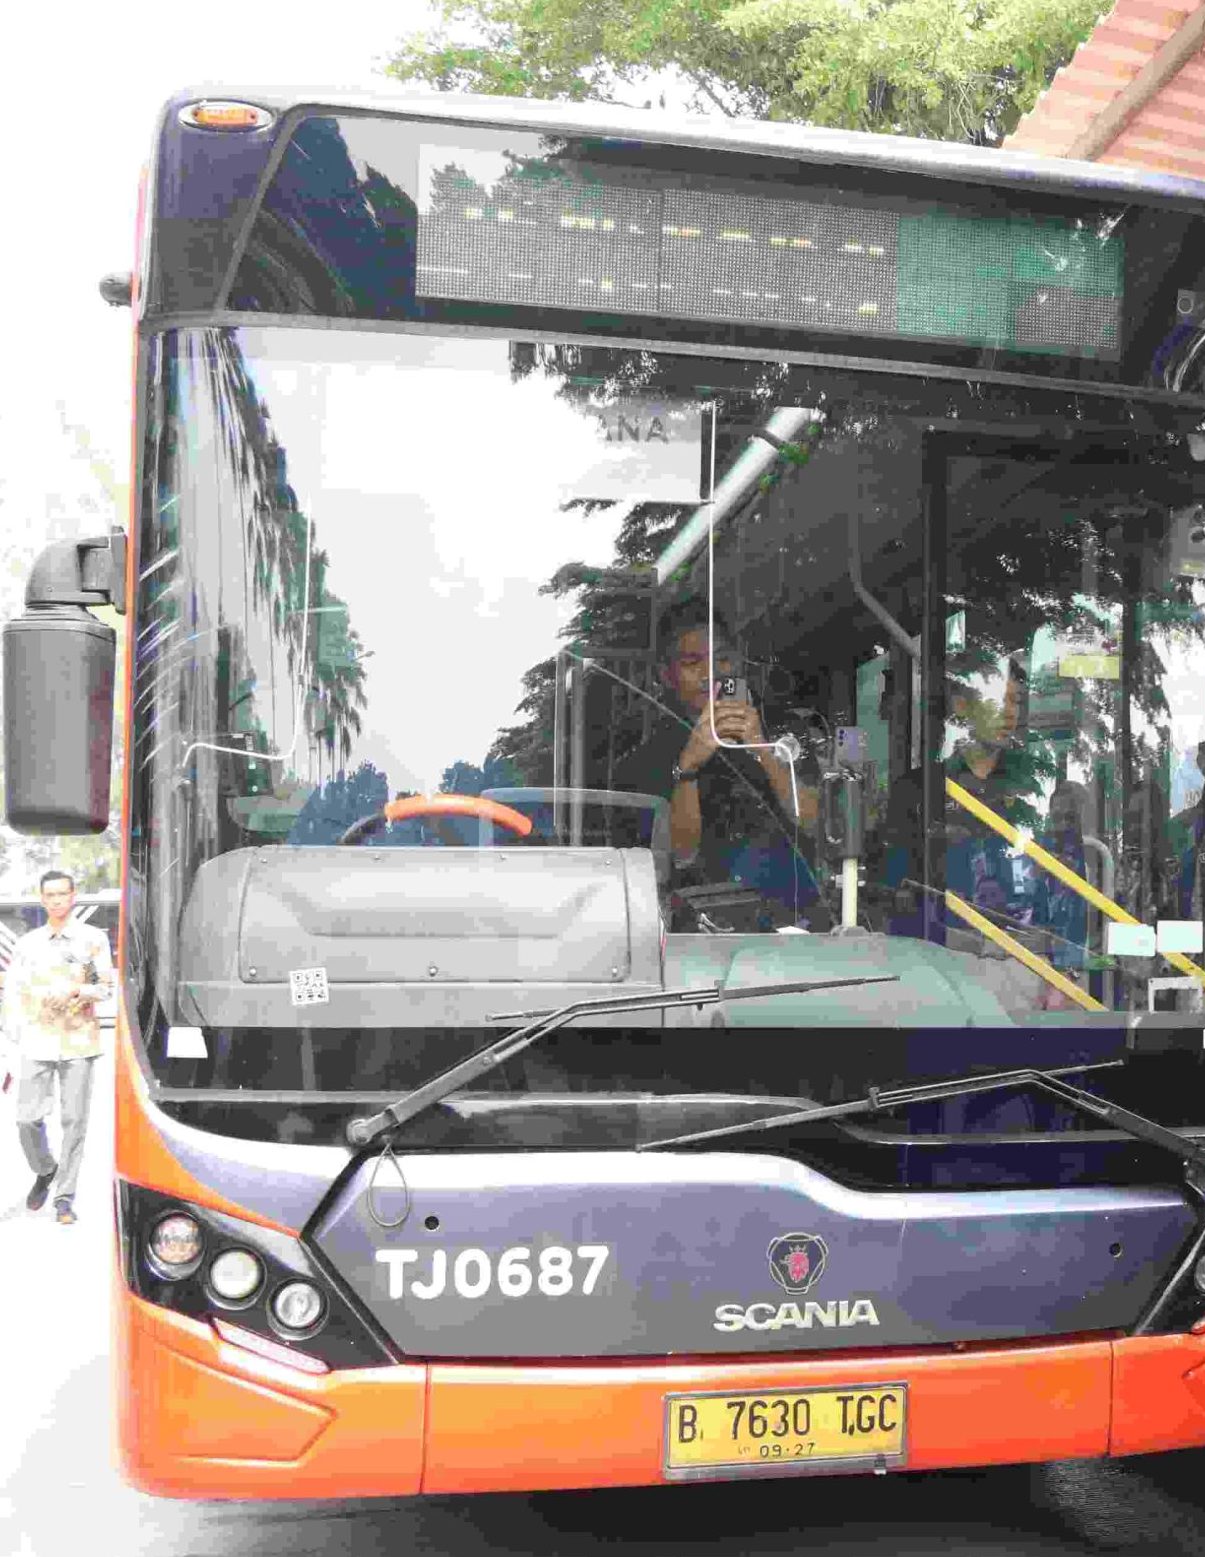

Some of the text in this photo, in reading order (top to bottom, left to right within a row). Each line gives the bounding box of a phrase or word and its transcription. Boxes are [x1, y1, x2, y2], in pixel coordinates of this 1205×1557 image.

[375, 1246, 609, 1299] TJ0687
[713, 1300, 880, 1332] SCANIA
[678, 1394, 897, 1443] B 7630 TGC
